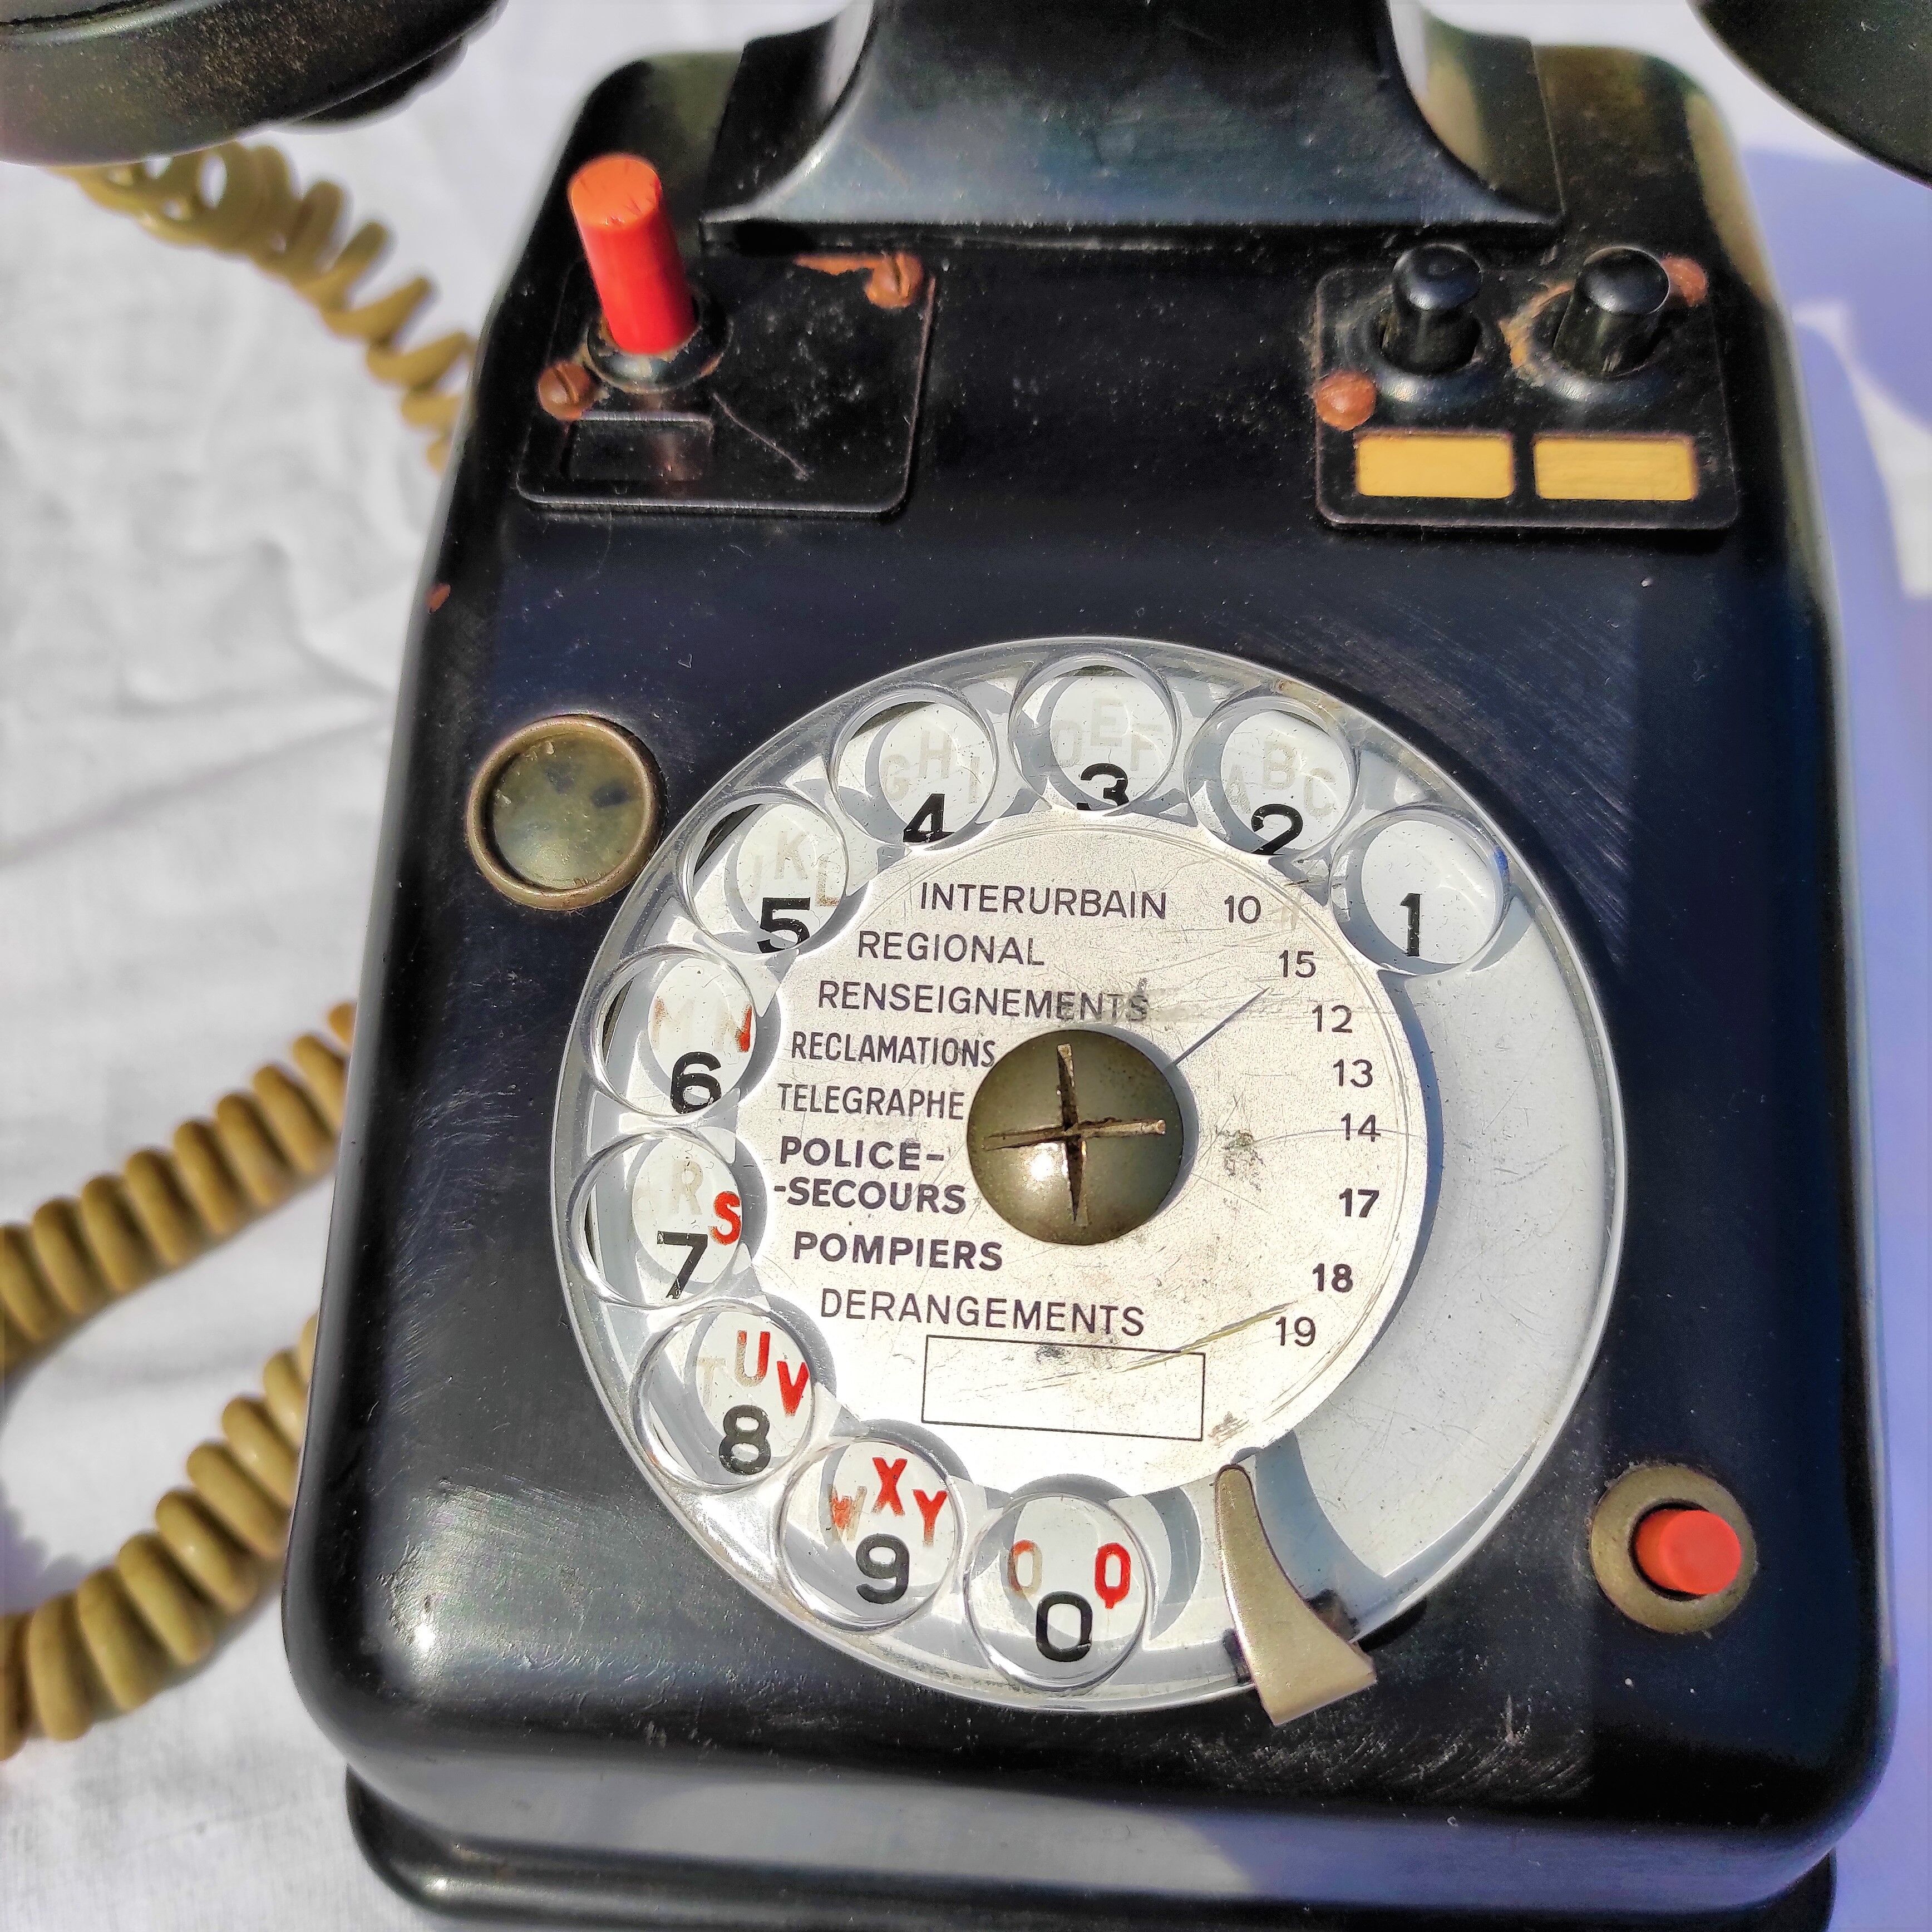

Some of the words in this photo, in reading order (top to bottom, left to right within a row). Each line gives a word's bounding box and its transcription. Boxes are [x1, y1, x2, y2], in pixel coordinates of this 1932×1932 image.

[1077, 763, 1129, 810] 3
[903, 793, 956, 842] 4
[1251, 803, 1303, 855] 2
[757, 896, 811, 953] 5
[920, 882, 1167, 920] INTERURBAIN
[1224, 895, 1261, 924] 10
[1399, 893, 1421, 957] 1
[858, 931, 1044, 966] REGIONAL
[1279, 949, 1317, 978] 15
[819, 980, 1149, 1022] RENSEIGNEMENTS
[1312, 1004, 1353, 1033] 12
[670, 1051, 722, 1115] 6
[791, 1031, 995, 1068] RECLAMATIONS
[1333, 1059, 1373, 1088] 13
[777, 1082, 965, 1120] TELEGRAPHE
[1340, 1113, 1381, 1142] 14
[780, 1136, 944, 1171] POLICE-
[773, 1176, 965, 1214] -SECOURS
[1339, 1187, 1379, 1218] 17
[657, 1230, 708, 1300] 7
[793, 1230, 1003, 1271] POMPIERS
[1312, 1263, 1353, 1293] 18
[821, 1288, 1145, 1336] DERANGEMENTS
[1275, 1316, 1316, 1347] 19
[696, 1330, 811, 1418] TUV
[718, 1404, 771, 1475] 8
[828, 1456, 948, 1547] WXY
[856, 1533, 910, 1604] 9
